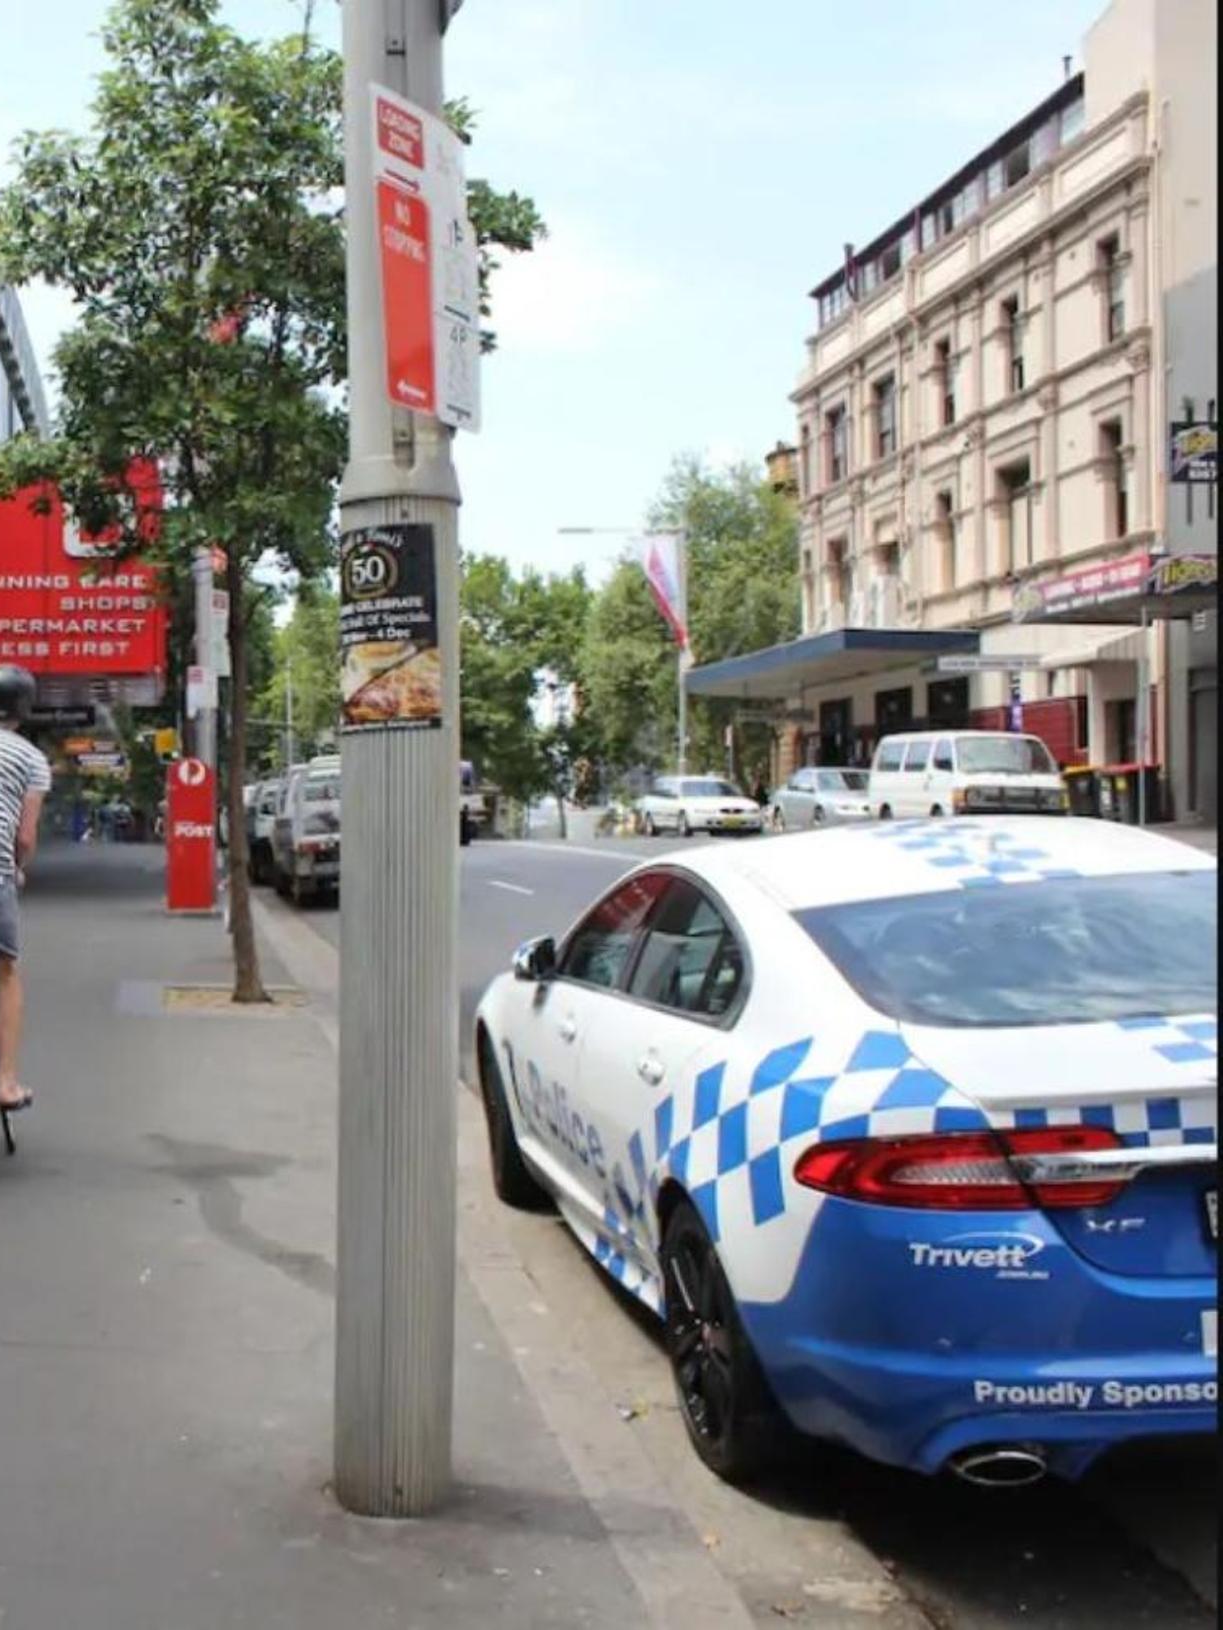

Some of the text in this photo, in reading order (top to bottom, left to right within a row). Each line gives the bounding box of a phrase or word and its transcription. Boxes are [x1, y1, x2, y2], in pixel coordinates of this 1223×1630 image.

[351, 555, 385, 585] 50
[60, 596, 148, 611] SHOPS
[58, 640, 130, 656] FIRST
[174, 821, 214, 838] POST
[908, 1241, 1026, 1268] Trivett
[973, 1379, 1094, 1408] Proudly
